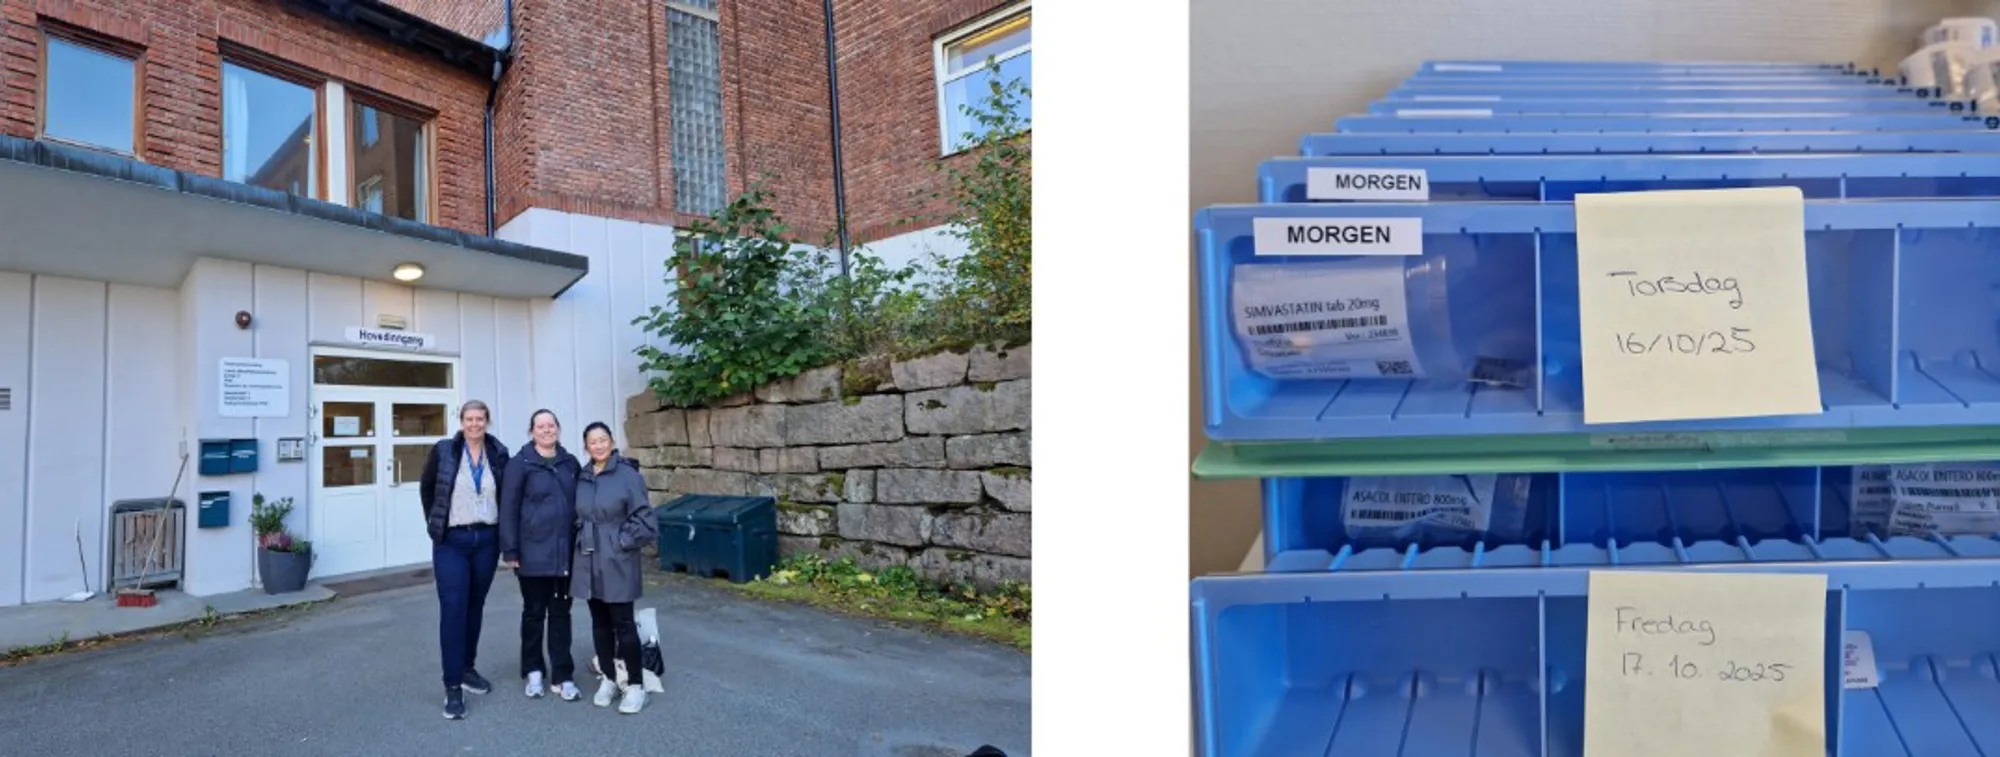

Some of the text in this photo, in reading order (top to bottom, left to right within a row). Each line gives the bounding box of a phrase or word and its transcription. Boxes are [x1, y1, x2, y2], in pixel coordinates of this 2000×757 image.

[1335, 174, 1421, 190] MORGEN
[1287, 225, 1391, 244] MORGEN
[1606, 271, 1743, 309] Torsdag
[1244, 297, 1380, 318] SIMVASTATIN tab 20mg
[1616, 327, 1756, 355] 16/10/25
[1352, 490, 1391, 504] ASACOL
[1616, 606, 1715, 646] Fredag
[1718, 660, 1794, 682] 2025
